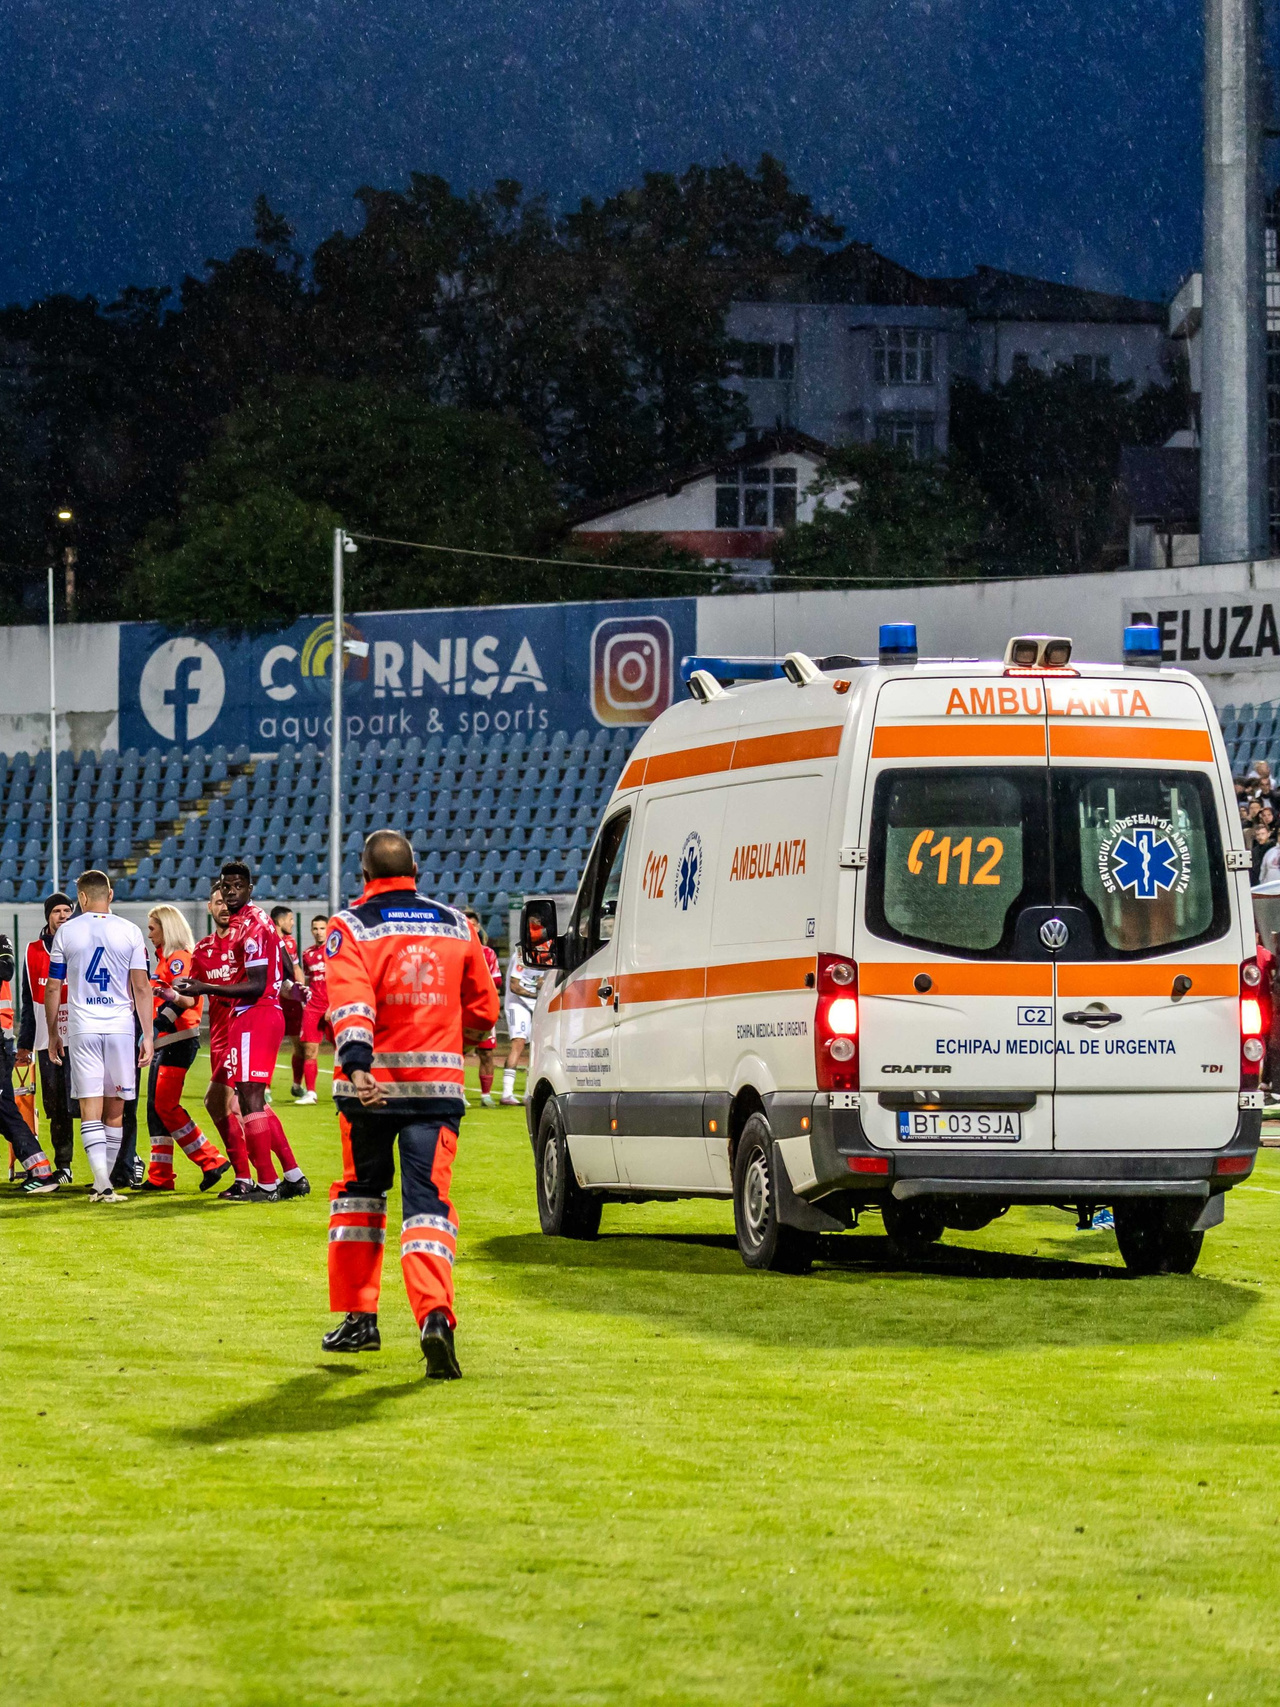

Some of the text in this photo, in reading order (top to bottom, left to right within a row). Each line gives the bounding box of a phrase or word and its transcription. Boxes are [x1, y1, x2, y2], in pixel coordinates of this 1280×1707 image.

[1131, 603, 1280, 662] ELUZA
[946, 687, 1151, 717] AMBULANTA
[459, 703, 549, 736] sports
[730, 839, 807, 881] AMBULANTA
[930, 836, 1004, 886] 112
[1098, 814, 1191, 894] SERVICIUL JUDETEAN DE AMBULANTA
[649, 854, 669, 899] 112
[387, 911, 435, 920] AMBULANTIER
[85, 946, 111, 992] 4
[86, 996, 115, 1005] MIRON
[1023, 1009, 1046, 1023] C2
[936, 1039, 1177, 1055] ECHIPAJ MEDICAL DE URGENTA
[880, 1064, 952, 1074] CRAFTER
[1200, 1064, 1224, 1074] TDI
[900, 1125, 910, 1134] RO
[914, 1114, 1015, 1134] BT 03 SJA
